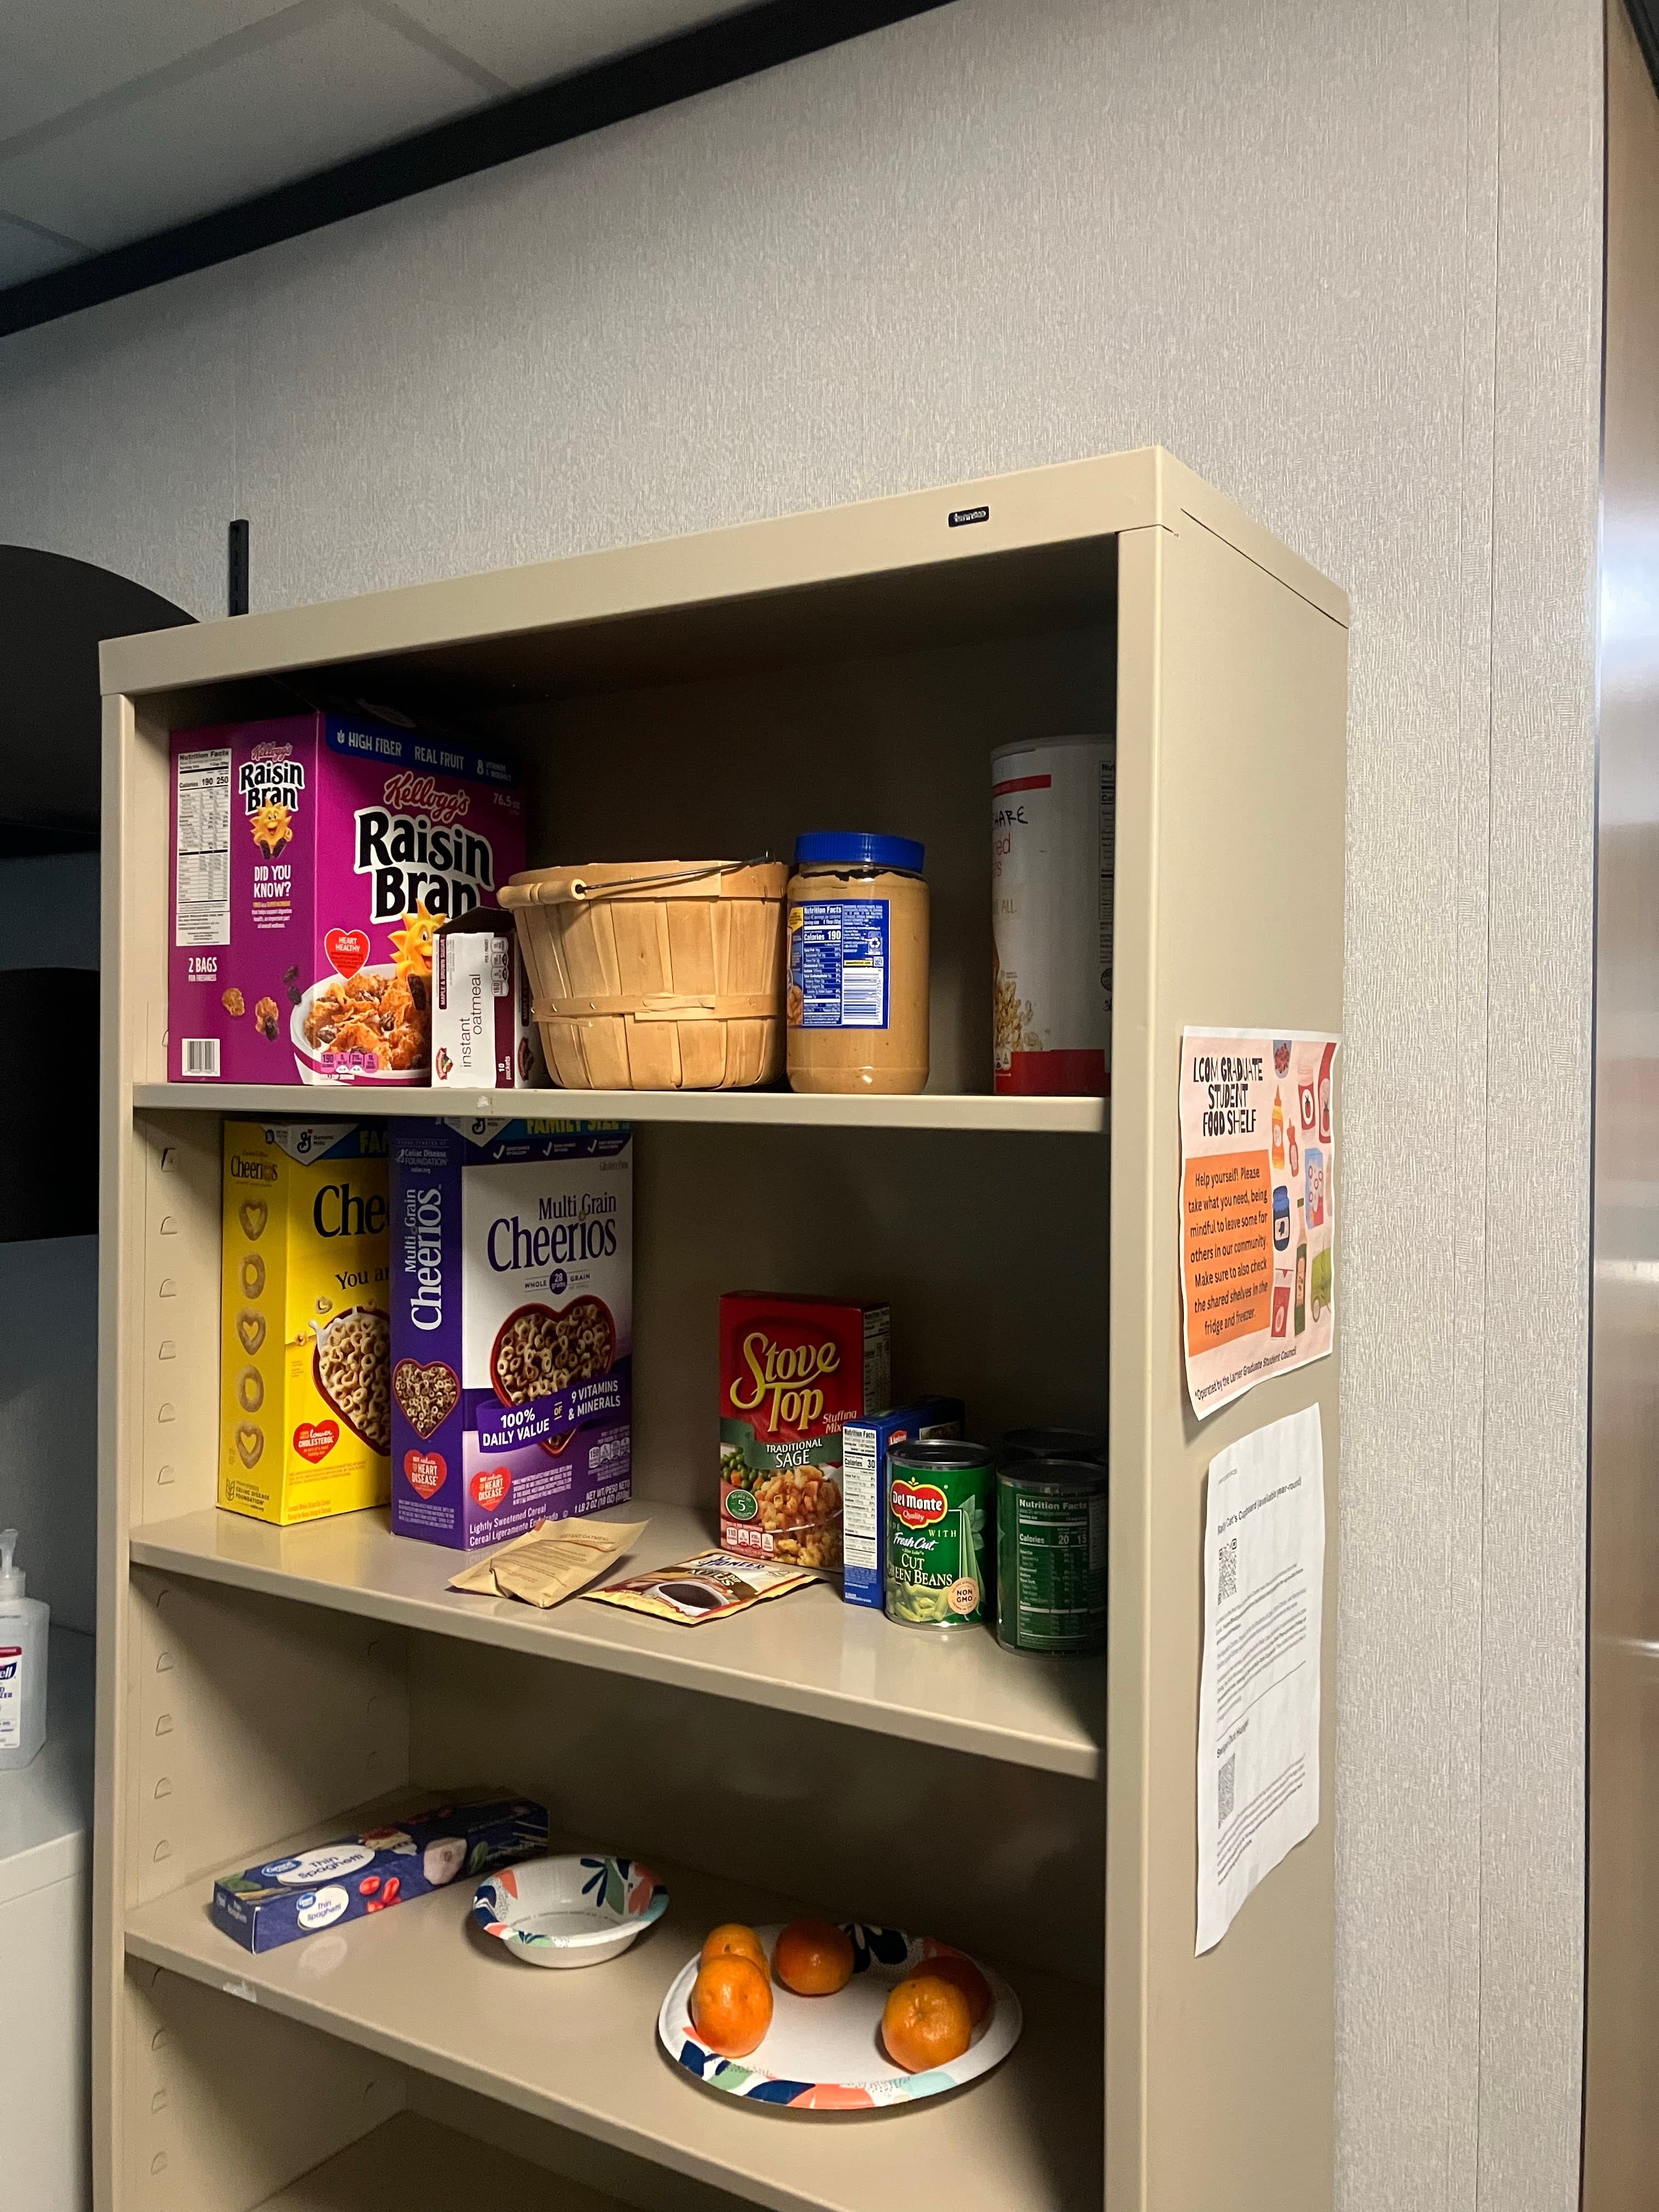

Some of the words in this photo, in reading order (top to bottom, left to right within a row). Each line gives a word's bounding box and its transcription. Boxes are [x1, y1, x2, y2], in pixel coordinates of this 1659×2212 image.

[251, 742, 292, 762] Kellogg's
[349, 732, 373, 751] HIGH
[375, 738, 402, 757] FIBER
[179, 752, 208, 761] Nutrition
[210, 749, 229, 758] Facts
[414, 746, 437, 765] REAL
[440, 752, 465, 771] FRUIT
[477, 759, 484, 775] 8
[202, 777, 213, 786] 190
[216, 776, 229, 785] 250
[240, 761, 304, 792] Raisin
[247, 787, 297, 814] Bran
[383, 771, 470, 822] Kellogg's
[493, 793, 512, 806] 76.5
[358, 812, 492, 888] Raisin
[254, 866, 269, 882] DID
[271, 865, 291, 880] YOU
[253, 881, 292, 898] KNOW?
[374, 868, 478, 919] Bran
[338, 936, 357, 945] HEART
[827, 930, 841, 940] 190
[335, 943, 360, 952] HEALTHY
[188, 957, 194, 973] 2
[195, 957, 218, 973] BAGS
[469, 974, 482, 1035] oatmeal
[460, 1018, 472, 1068] instant
[498, 1063, 505, 1073] 10
[1193, 1057, 1218, 1083] LCOM
[1221, 1057, 1263, 1082] GRADUATE
[1208, 1083, 1248, 1110] STUDENT
[1203, 1110, 1225, 1137] FOOD
[1227, 1109, 1256, 1136] SHELF
[404, 1157, 448, 1166] FOUNDATION
[423, 1149, 447, 1158] Disease
[599, 1162, 618, 1171] Gluten
[1195, 1173, 1210, 1188] Help
[1211, 1167, 1239, 1189] yourself!
[1240, 1167, 1260, 1179] Please
[404, 1189, 416, 1227] Grain
[539, 1195, 577, 1221] Multi
[581, 1192, 617, 1215] Grain
[1188, 1199, 1202, 1214] take
[1203, 1195, 1219, 1211] what
[1220, 1196, 1232, 1212] you
[1233, 1190, 1250, 1205] need,
[1251, 1189, 1268, 1204] being
[1190, 1219, 1216, 1238] mindful
[1217, 1218, 1224, 1232] to
[1225, 1215, 1240, 1231] leave
[1241, 1215, 1257, 1228] some
[1259, 1211, 1268, 1224] for
[487, 1215, 617, 1272] Cheerios
[1190, 1246, 1214, 1263] others
[1214, 1244, 1221, 1257] in
[1222, 1244, 1233, 1257] our
[1234, 1234, 1268, 1254] community.
[404, 1236, 416, 1273] Multi
[410, 1188, 442, 1330] Cheerios
[335, 1268, 369, 1290] You
[554, 1272, 563, 1283] 28
[569, 1273, 590, 1282] GRAIN
[1195, 1271, 1213, 1288] Make
[1214, 1268, 1229, 1283] sure
[1229, 1266, 1237, 1279] to
[1237, 1262, 1250, 1277] also
[1250, 1256, 1267, 1273] check
[524, 1280, 547, 1289] WHOLE
[1194, 1298, 1206, 1313] the
[1207, 1291, 1229, 1309] shared
[1230, 1286, 1252, 1304] shelves
[1252, 1284, 1259, 1296] in
[1259, 1282, 1268, 1294] the
[1204, 1318, 1223, 1336] fridge
[1224, 1314, 1235, 1328] and
[1235, 1308, 1256, 1324] freezer.
[730, 1333, 840, 1409] Stove
[1217, 1380, 1222, 1392] by
[1243, 1359, 1262, 1376] Graduate
[1263, 1354, 1280, 1368] Student
[1280, 1345, 1297, 1361] Council
[571, 1390, 577, 1403] 9
[578, 1379, 618, 1401] VITAMINS
[554, 1404, 563, 1417] OF
[568, 1408, 574, 1421] &
[577, 1395, 620, 1418] MINERALS
[766, 1383, 823, 1432] Top
[500, 1407, 535, 1429] 100%
[822, 1410, 857, 1425] Stuffing
[310, 1429, 332, 1438] lower
[483, 1430, 515, 1447] DAILY
[517, 1418, 550, 1441] VALUE
[825, 1422, 843, 1434] Mix
[844, 1428, 862, 1437] Nutrition
[863, 1430, 875, 1438] Facts
[298, 1436, 334, 1448] CHOLESTEROL
[766, 1438, 823, 1454] TRADITIONAL
[776, 1449, 810, 1468] SAGE
[844, 1458, 862, 1467] Calories
[867, 1459, 875, 1469] 30
[417, 1463, 437, 1476] HEART
[411, 1472, 437, 1486] DISEASE
[484, 1478, 503, 1489] HEART
[235, 1493, 264, 1505] FOUNDATION
[251, 1491, 270, 1500] DISEASE
[478, 1488, 503, 1502] DISEASE
[586, 1491, 596, 1502] NET
[892, 1491, 905, 1507] Del
[906, 1494, 943, 1511] Monte
[578, 1503, 585, 1513] LB
[590, 1498, 597, 1509] OZ
[737, 1499, 746, 1511] 5
[1019, 1499, 1060, 1510] Nutrition
[1063, 1501, 1087, 1510] Facts
[470, 1520, 493, 1534] Lightly
[494, 1509, 527, 1528] Sweetened
[527, 1503, 546, 1517] Cereal
[902, 1510, 924, 1522] Quality
[470, 1532, 492, 1547] Cereal
[492, 1522, 528, 1541] Ligeramente
[893, 1532, 915, 1548] Fresh
[928, 1529, 957, 1538] WITH
[1019, 1533, 1045, 1544] Calories
[1058, 1534, 1069, 1545] 20
[1077, 1534, 1087, 1544] 15
[901, 1553, 925, 1571] CUT
[888, 1562, 911, 1583] GREEN
[914, 1570, 952, 1587] BEANS
[298, 1853, 364, 1879] Spaghetti
[309, 1855, 339, 1867] Thin
[307, 1903, 341, 1921] Spaghetti
[318, 1900, 331, 1910] Thin
